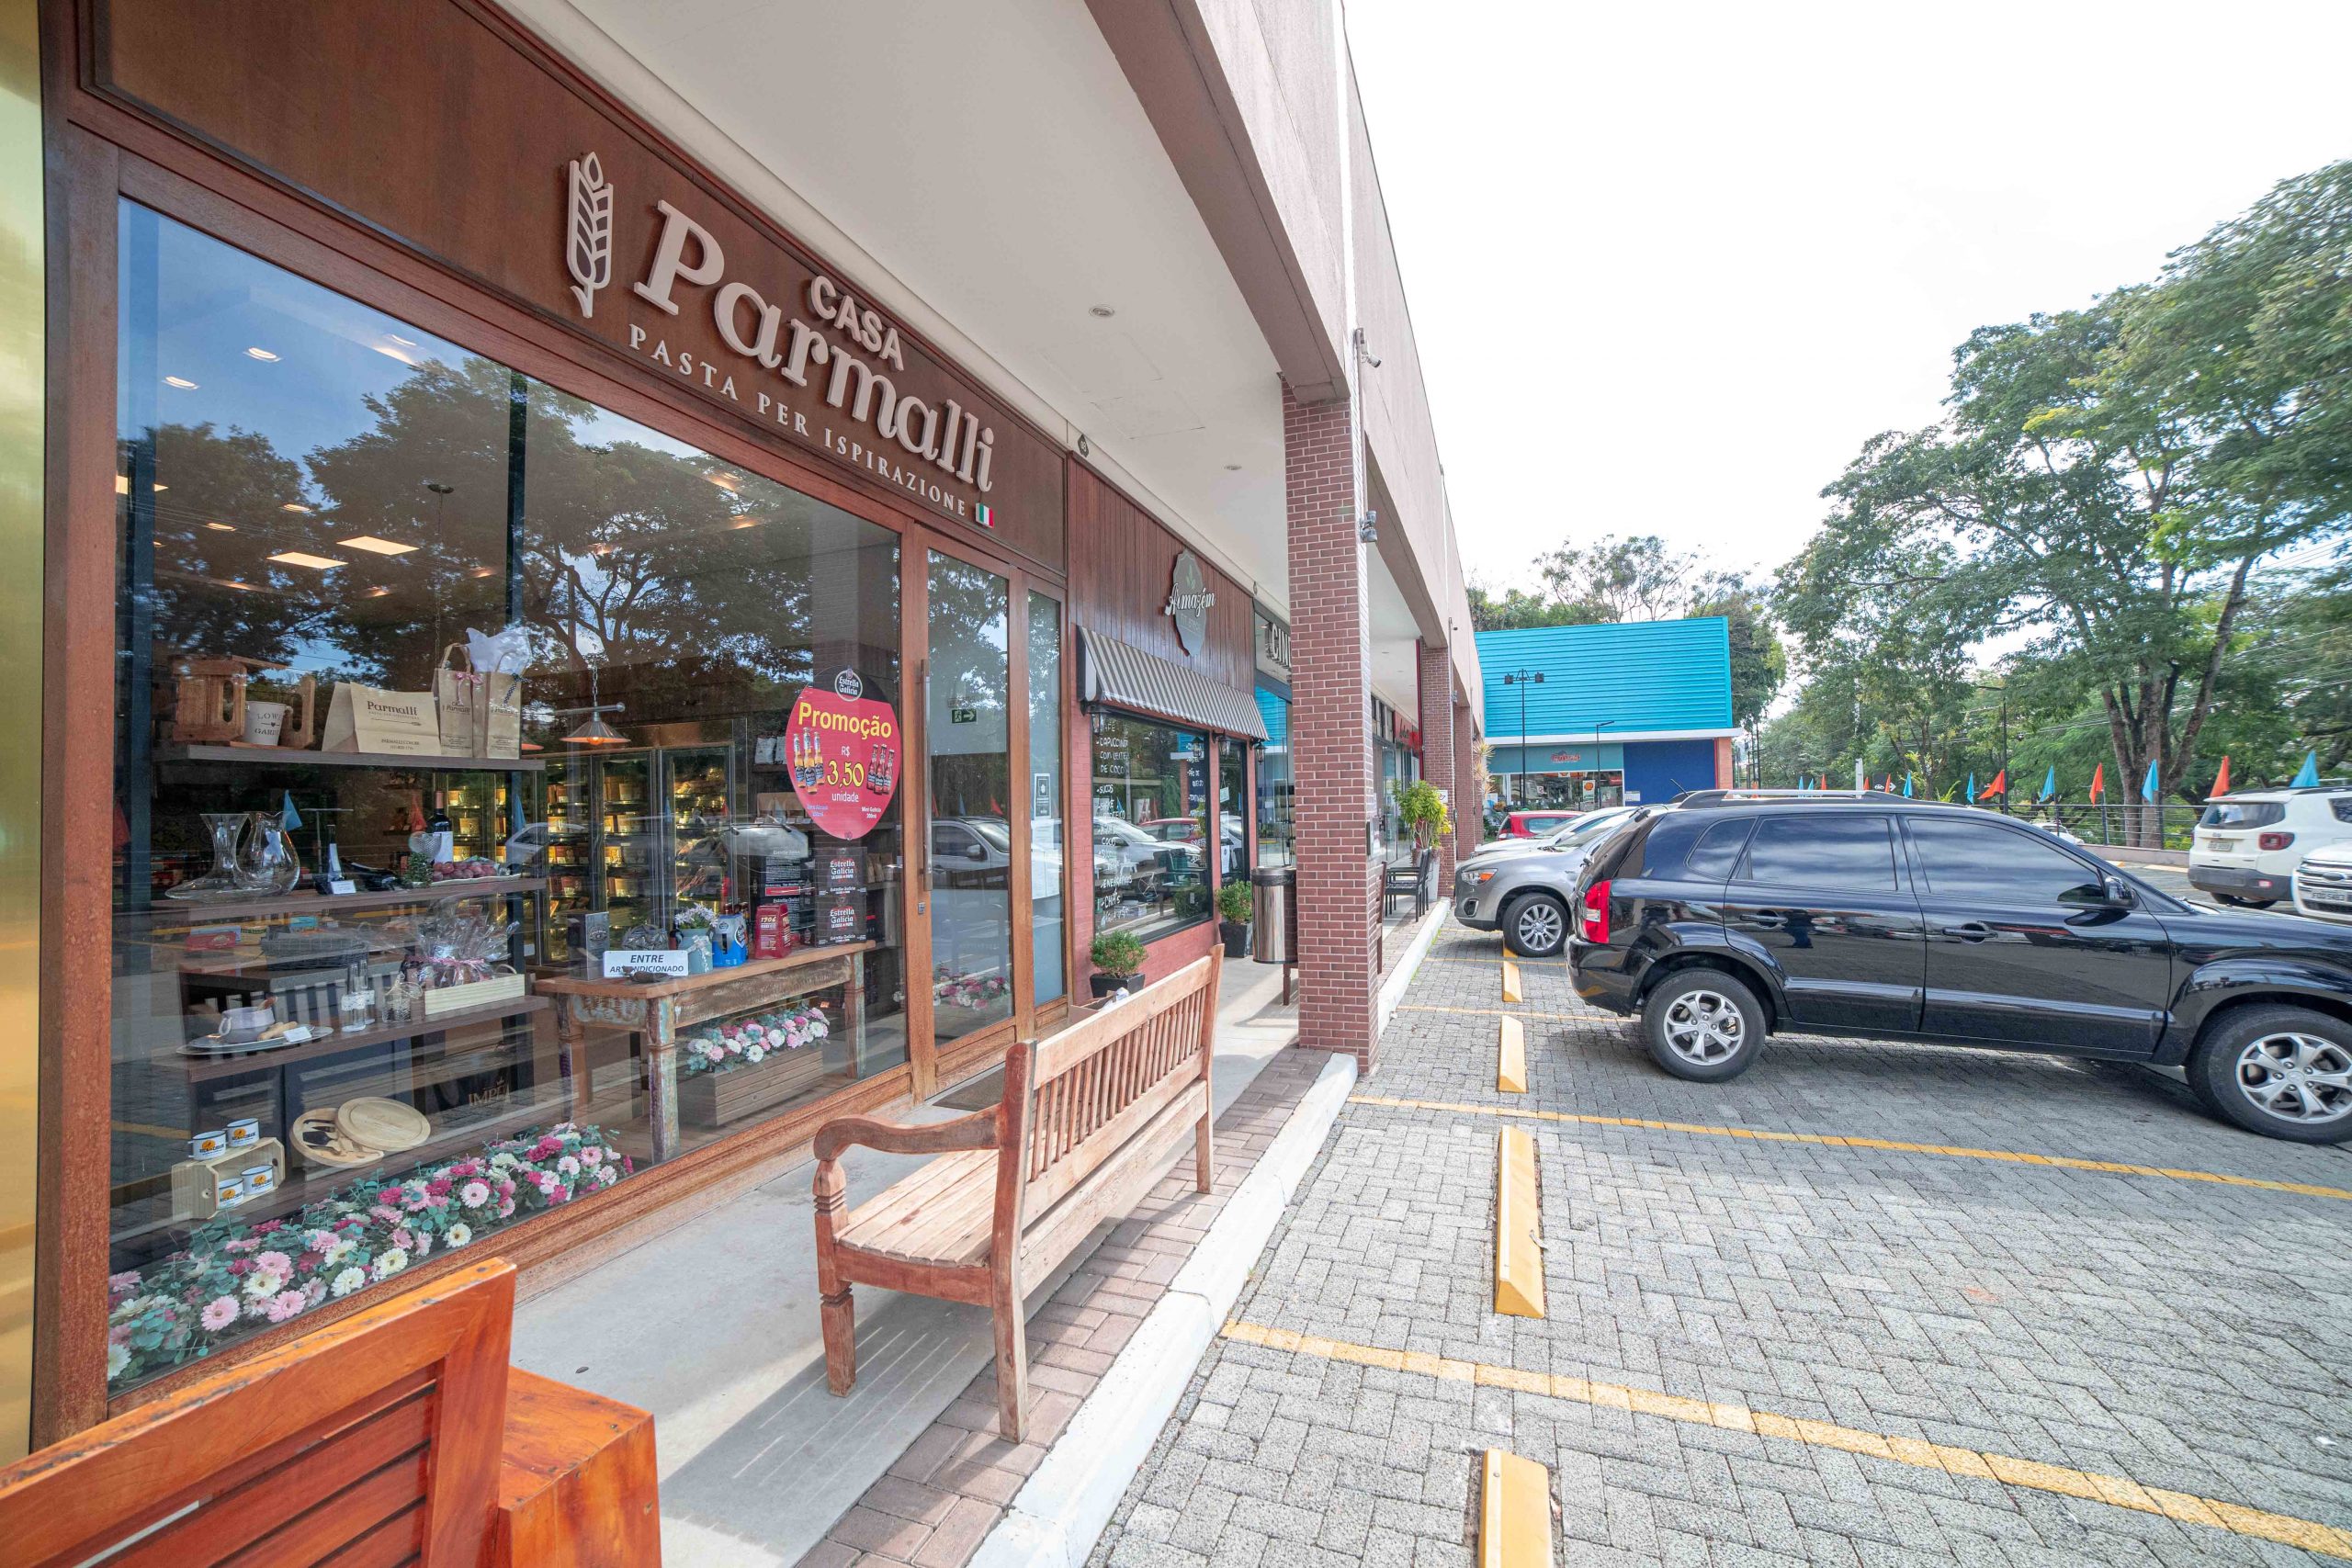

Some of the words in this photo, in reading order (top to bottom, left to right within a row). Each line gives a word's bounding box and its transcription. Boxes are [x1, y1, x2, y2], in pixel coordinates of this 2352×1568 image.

[810, 275, 904, 372] CASA
[633, 199, 995, 493] Parmalli
[628, 323, 739, 400] PASTA
[757, 392, 809, 437] PER
[825, 428, 967, 517] ISPIRAZIONE
[1164, 582, 1216, 617] Armazém
[839, 676, 859, 688] Estrella
[367, 700, 418, 716] Parmalli
[798, 702, 892, 740] Promoção
[841, 746, 851, 757] R$
[827, 760, 865, 788] 3,50
[1110, 765, 1125, 774] COCO
[1099, 784, 1114, 794] SUCOS
[831, 792, 860, 802] unidade
[830, 860, 855, 868] Estrella
[831, 867, 854, 875] Galicia
[830, 908, 854, 917] Estrella
[831, 916, 854, 924] Galicia
[630, 954, 664, 964] ENTRE
[623, 965, 684, 974] NDICIONADO
